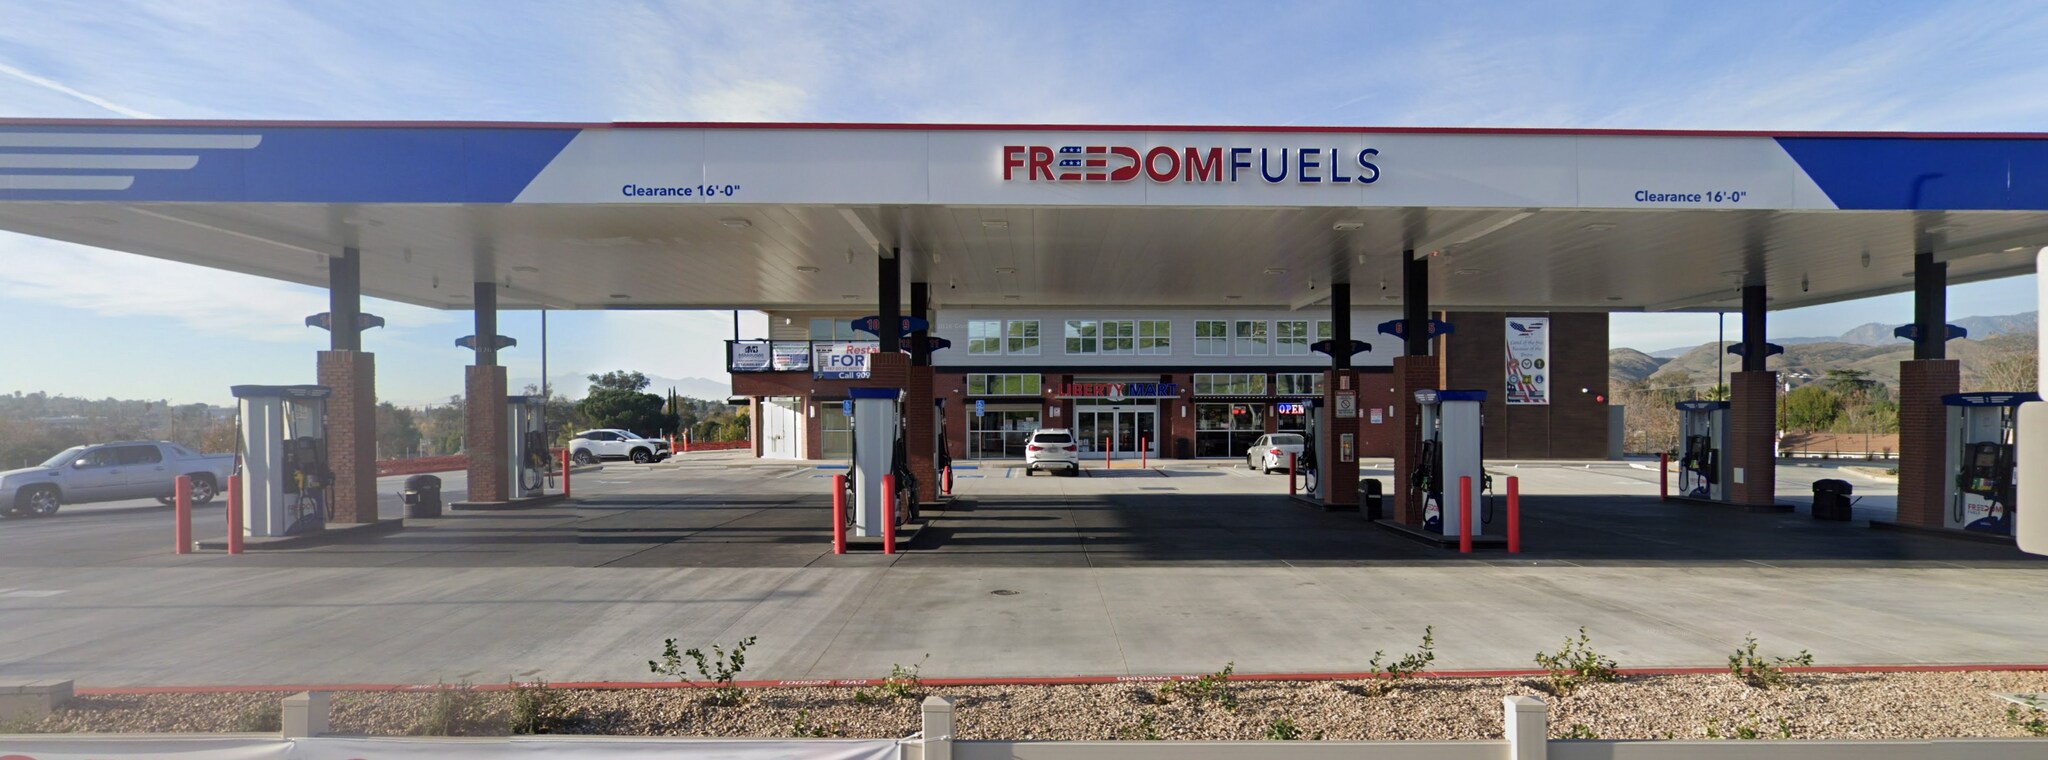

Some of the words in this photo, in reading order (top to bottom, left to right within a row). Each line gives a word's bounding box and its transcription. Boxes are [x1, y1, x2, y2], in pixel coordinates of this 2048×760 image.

[622, 184, 692, 197] Clearance
[697, 184, 741, 197] 16'-0"
[1634, 190, 1702, 203] Clearance
[1706, 191, 1746, 203] 16'-0"
[902, 319, 910, 330] 9
[831, 355, 865, 366] FOR
[1057, 383, 1127, 397] LIBERTY
[1128, 383, 1178, 397] MART
[1278, 403, 1305, 415] OPEN
